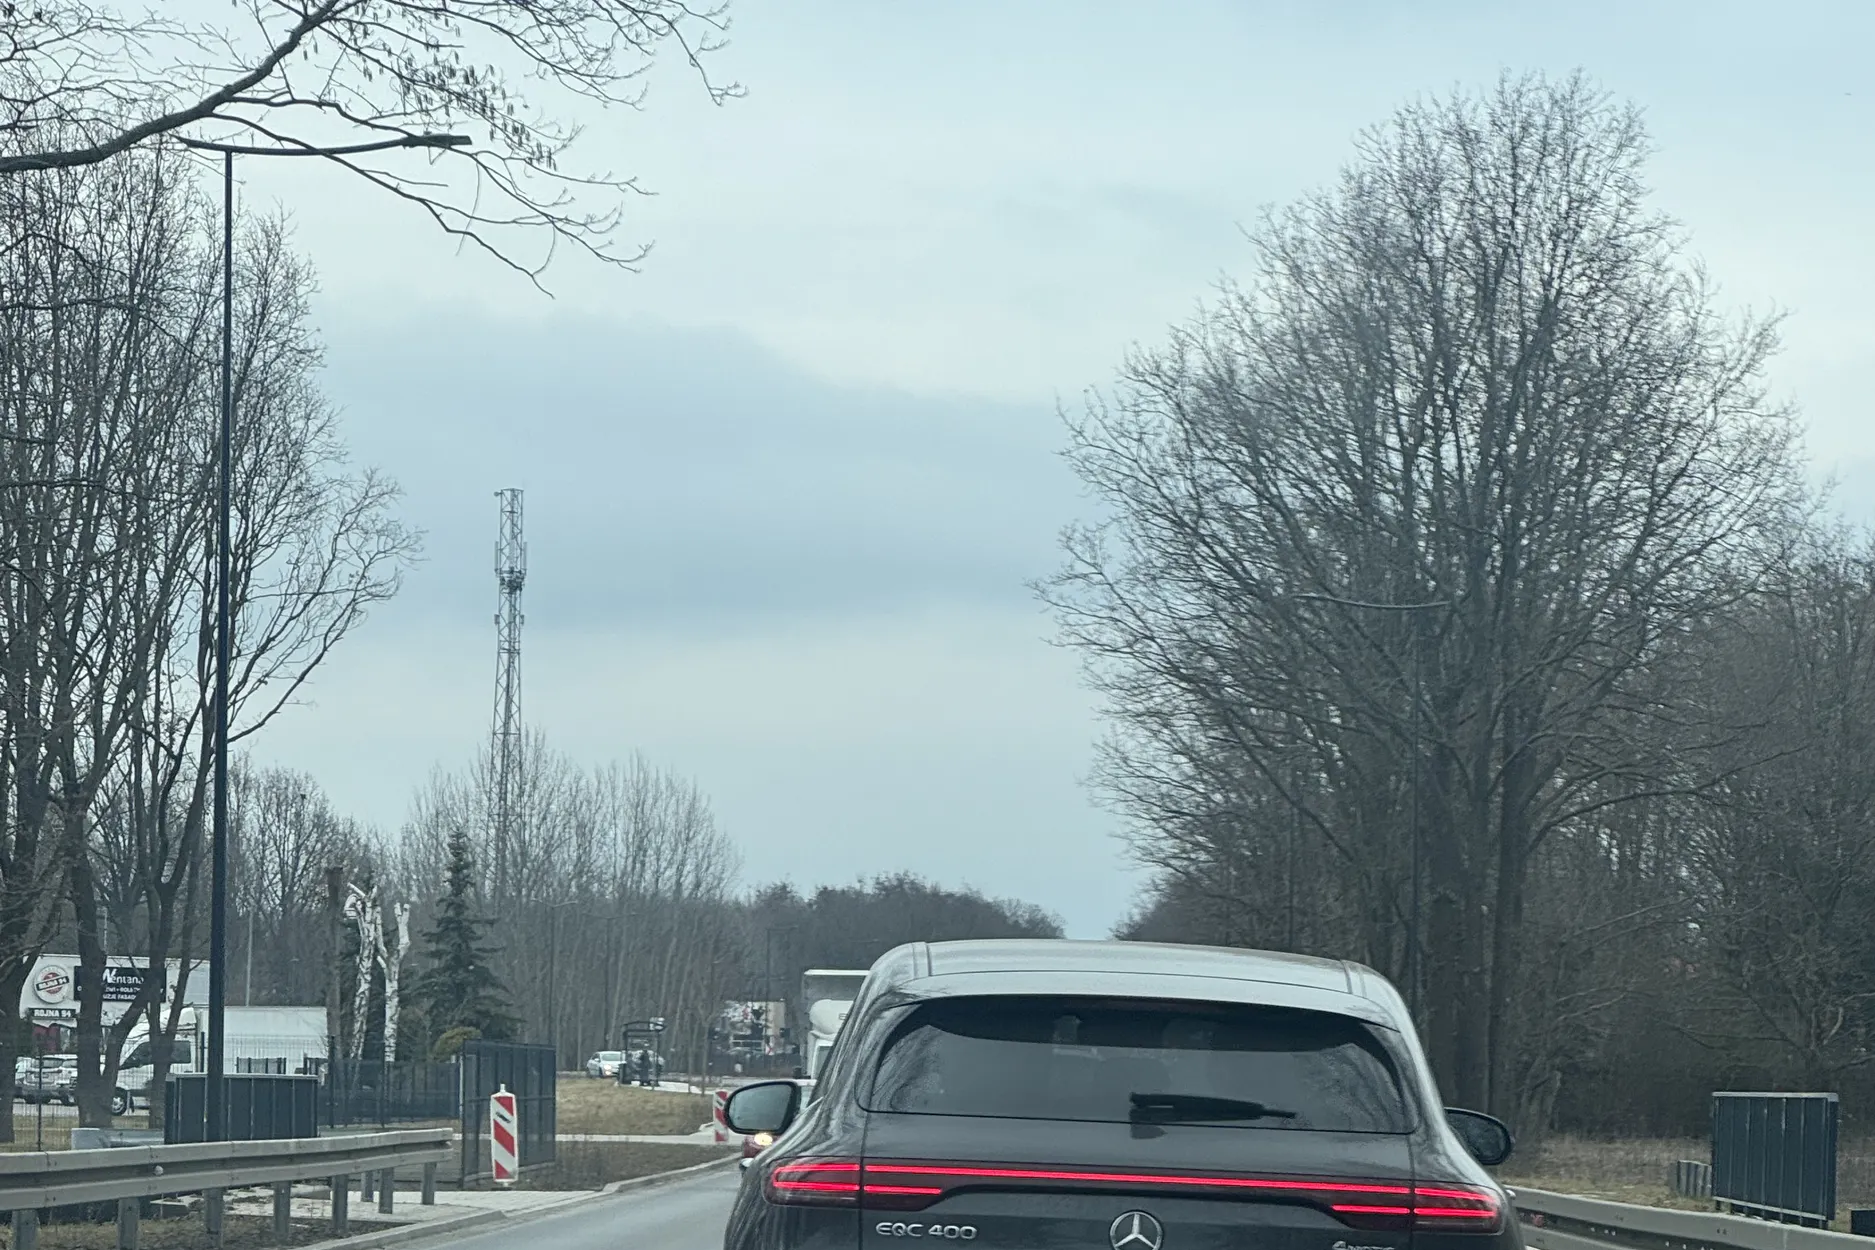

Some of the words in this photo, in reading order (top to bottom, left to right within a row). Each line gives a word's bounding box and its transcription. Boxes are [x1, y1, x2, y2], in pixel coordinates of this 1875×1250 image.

[34, 1009, 60, 1018] ROJNA
[61, 1009, 72, 1018] 94
[875, 1222, 924, 1237] EQC
[928, 1224, 978, 1240] 400
